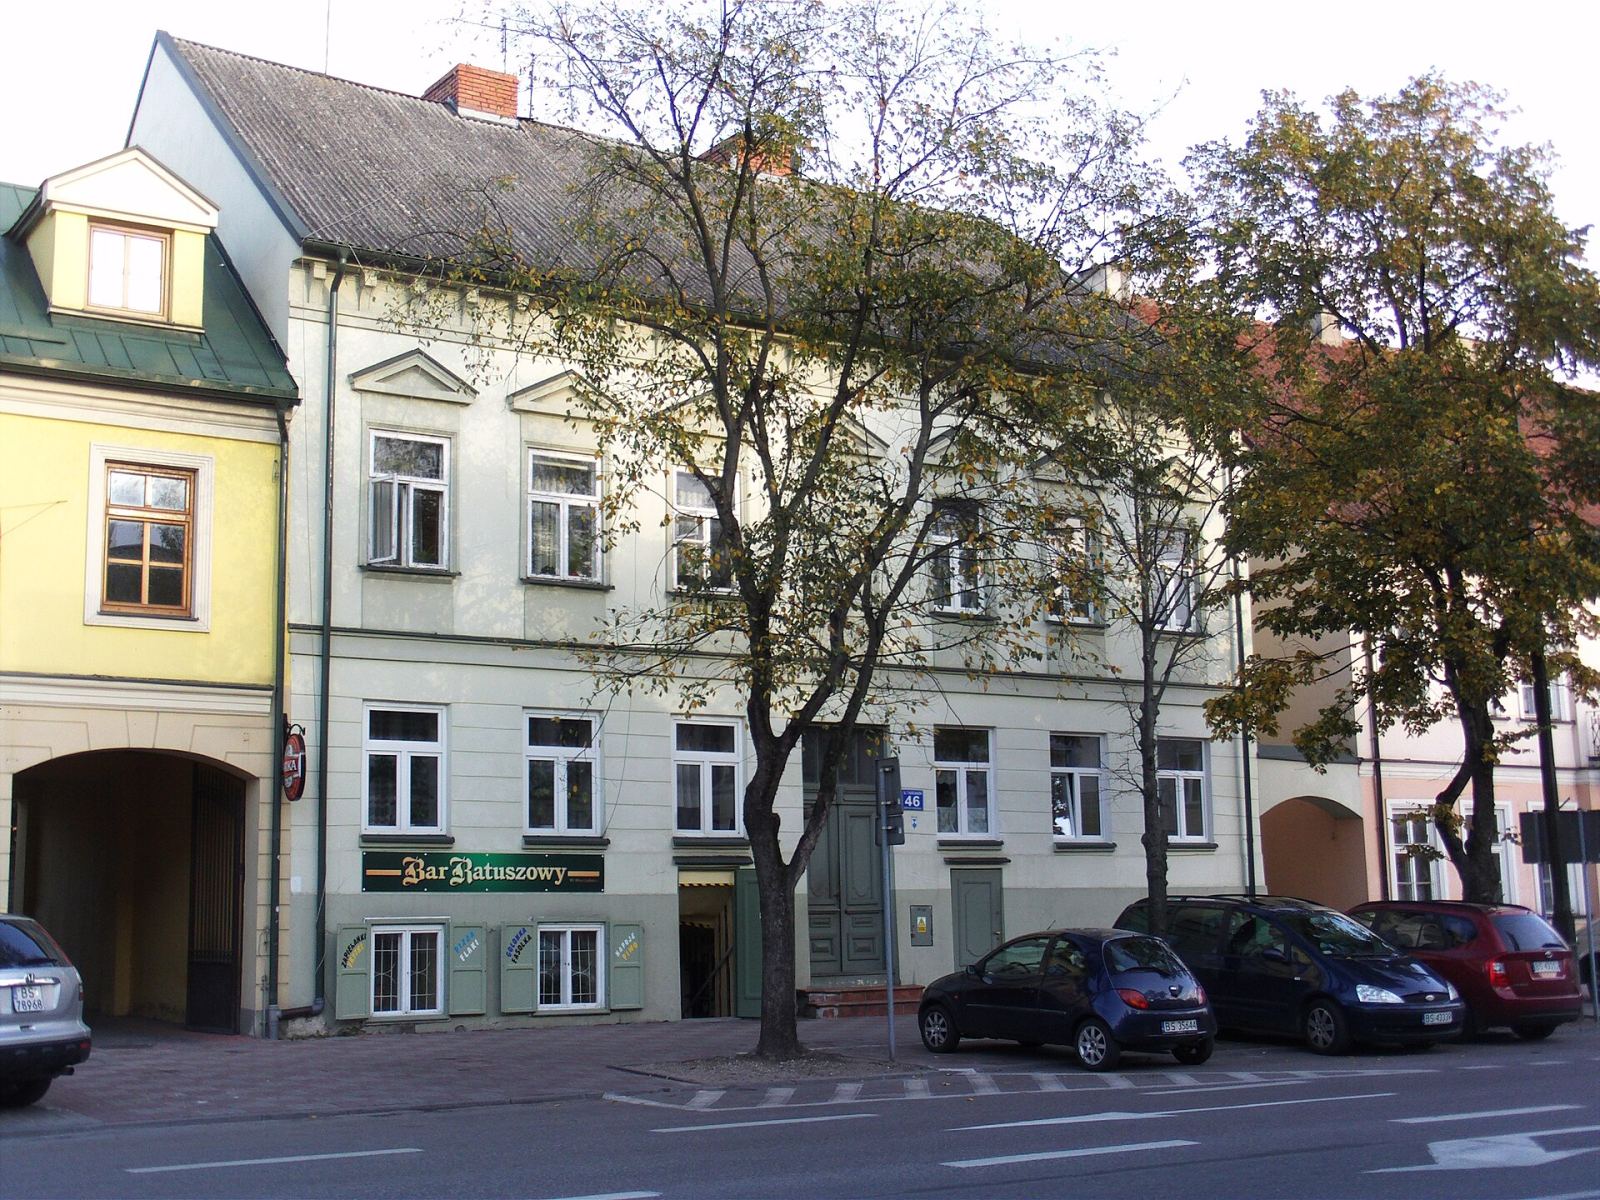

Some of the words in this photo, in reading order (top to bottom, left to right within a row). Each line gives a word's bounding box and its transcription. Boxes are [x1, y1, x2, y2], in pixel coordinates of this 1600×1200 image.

[904, 795, 920, 807] 46
[402, 856, 449, 886] Bar
[449, 856, 567, 887] Ratuszowy
[21, 987, 35, 999] BS
[1165, 1022, 1176, 1031] BS
